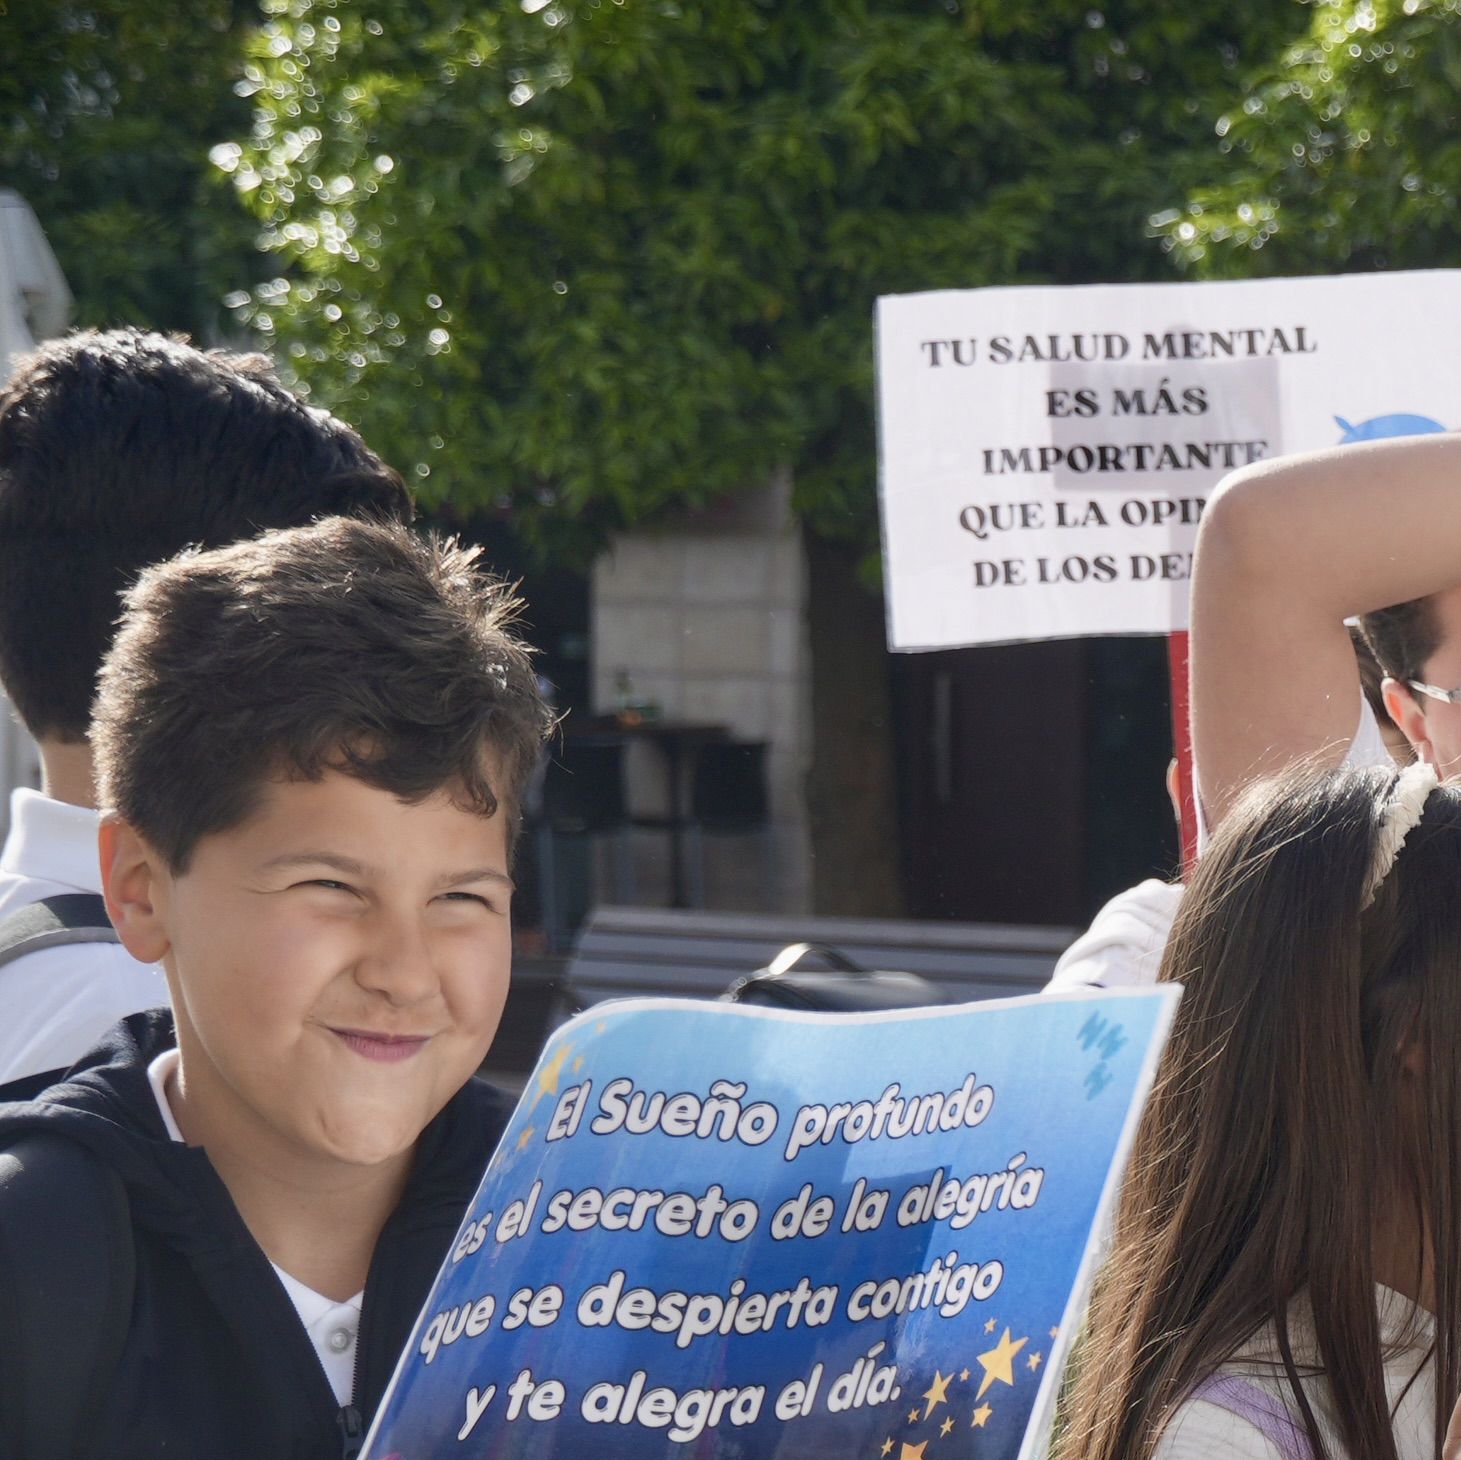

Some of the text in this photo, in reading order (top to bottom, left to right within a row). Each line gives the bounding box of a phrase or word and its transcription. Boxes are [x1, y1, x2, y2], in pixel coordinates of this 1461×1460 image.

[921, 326, 1318, 367] TU SALUD MENTAL
[1046, 377, 1209, 418] ES MÁS
[982, 440, 1269, 475] IMPORTANTE
[959, 502, 1045, 539] QUE
[1056, 500, 1109, 528] LA
[974, 552, 1193, 587] DE LOS DE
[545, 1072, 995, 1162] El Sueño profundo
[452, 1151, 1045, 1264] es el secreto de la alegría
[419, 1249, 1004, 1366] que se despierta contigo
[457, 1340, 902, 1444] y te alegra el día.
